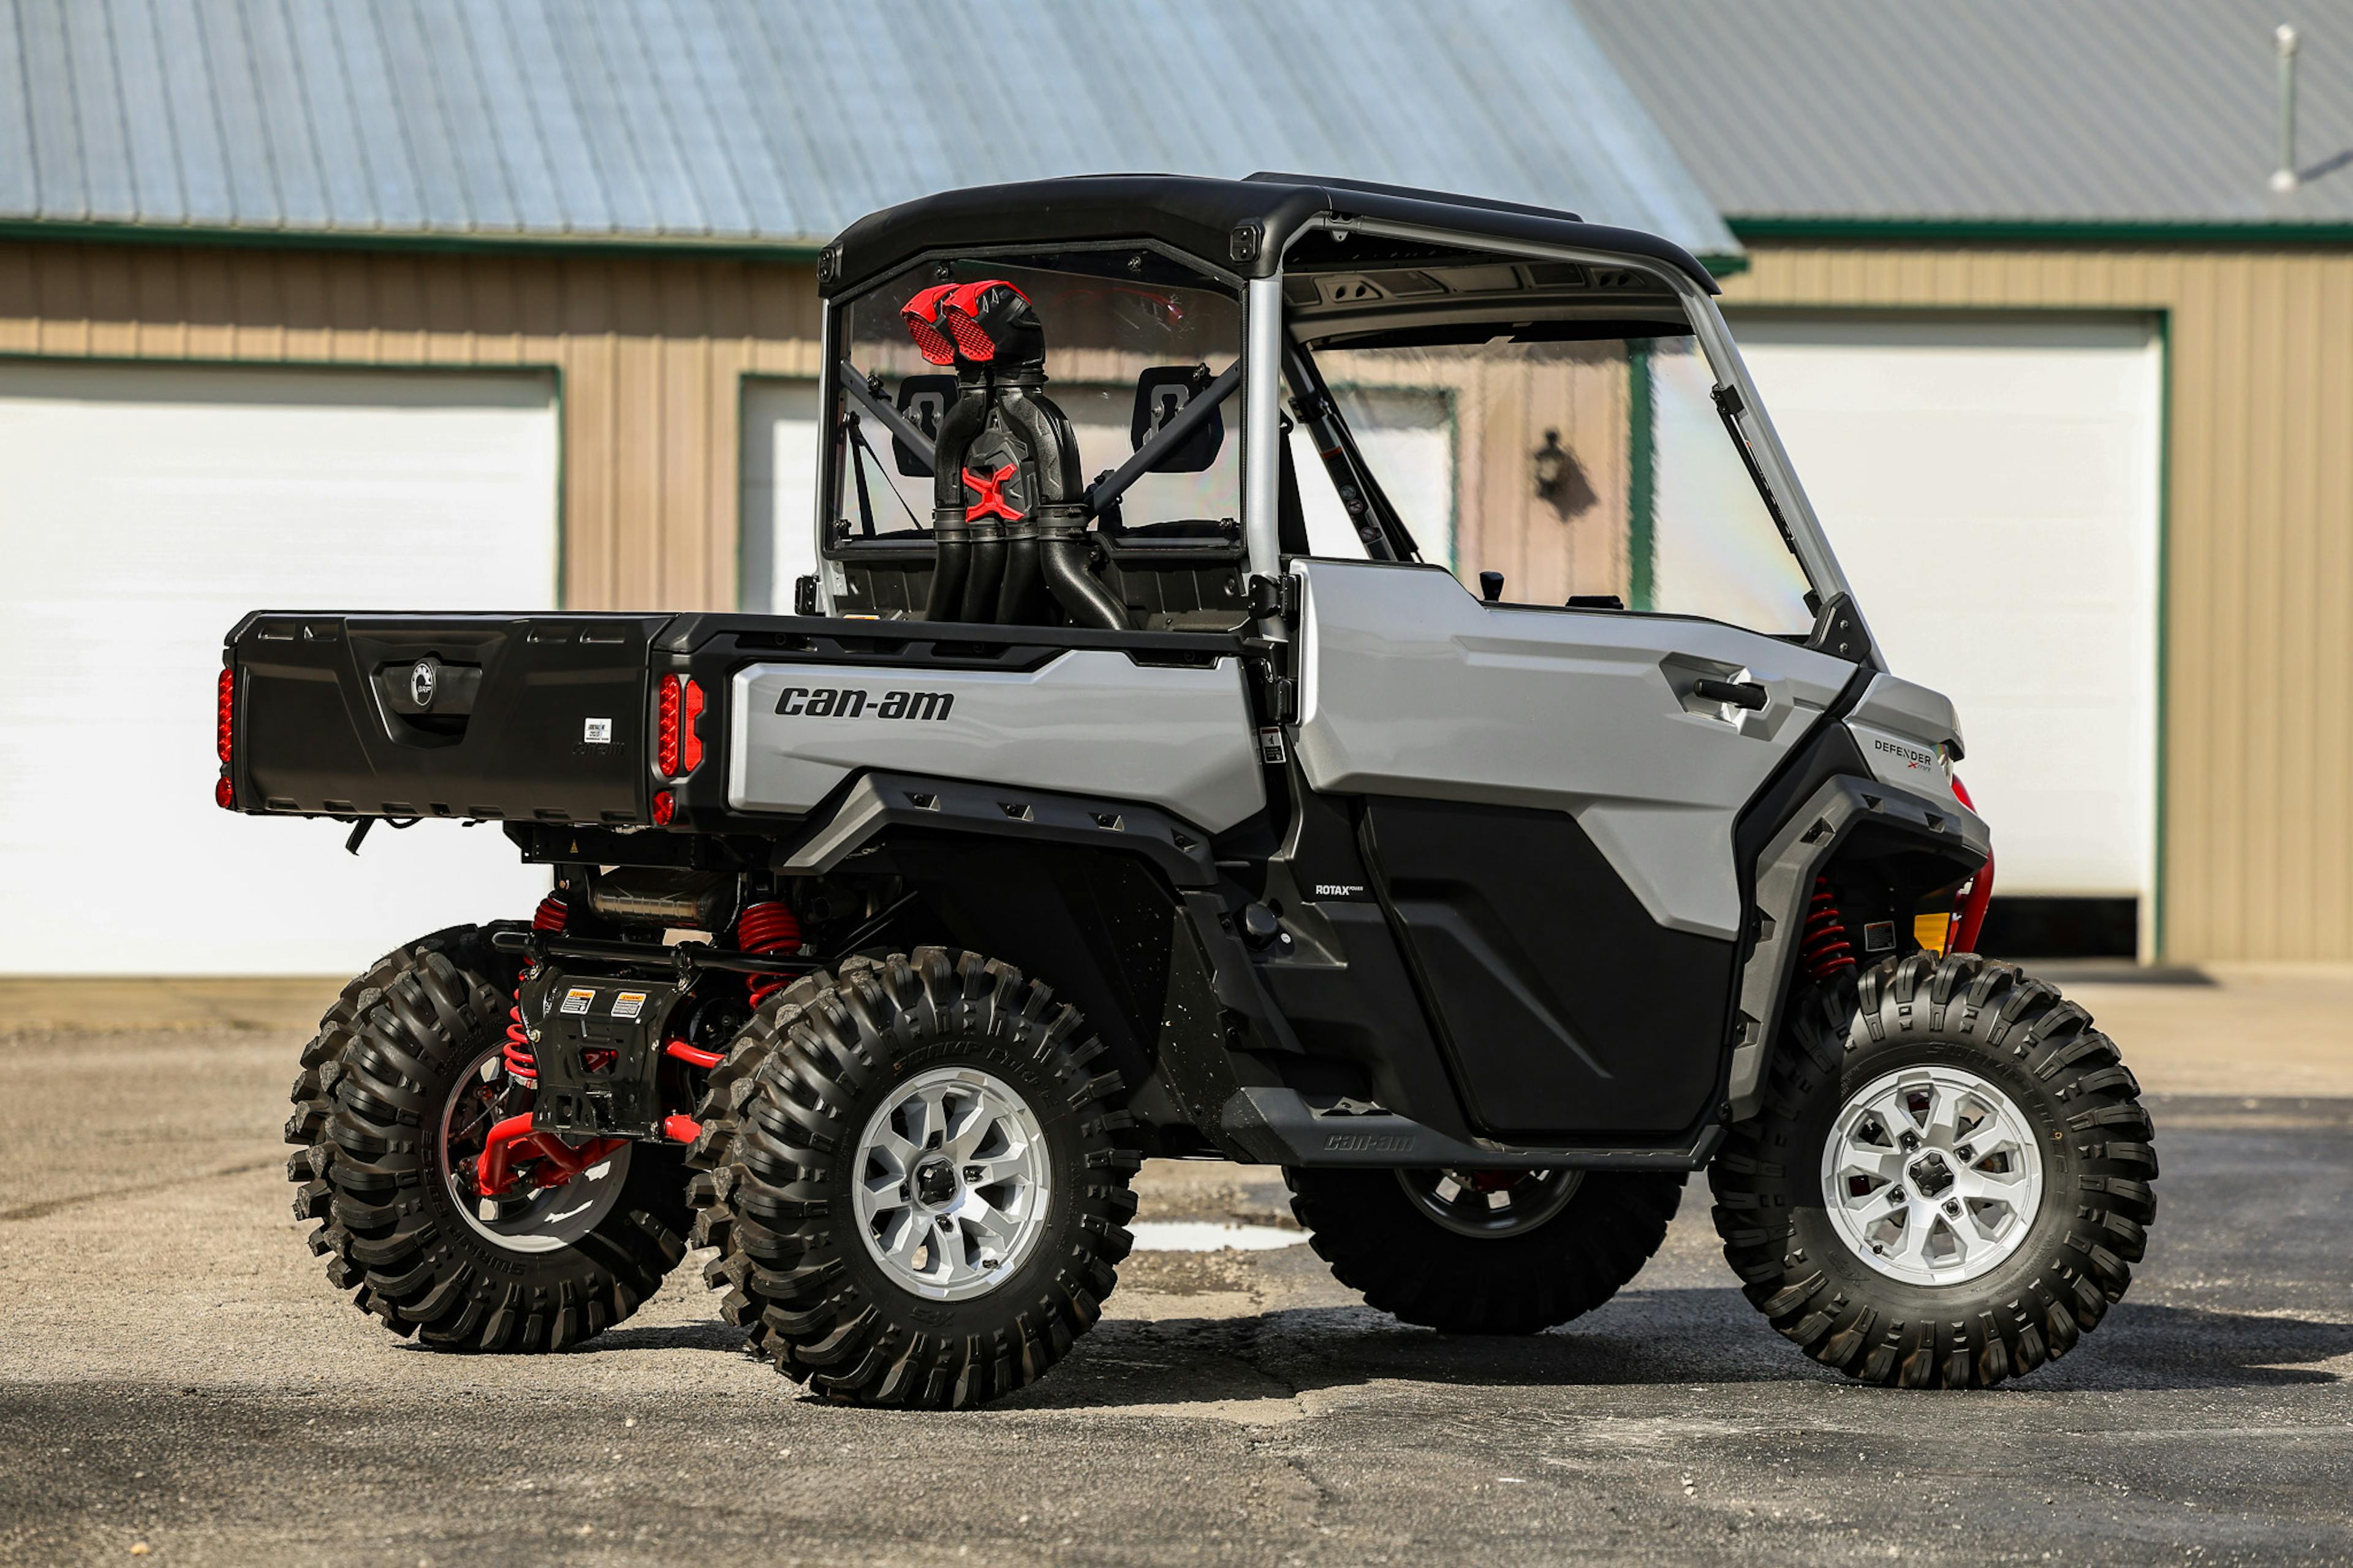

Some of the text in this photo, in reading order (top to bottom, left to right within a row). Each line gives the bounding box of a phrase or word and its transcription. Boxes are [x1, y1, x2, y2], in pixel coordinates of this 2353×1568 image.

[775, 687, 953, 721] can-am
[1875, 740, 1931, 765] DEFENDER
[1316, 885, 1349, 895] ROTAX
[1324, 1134, 1416, 1151] can-am
